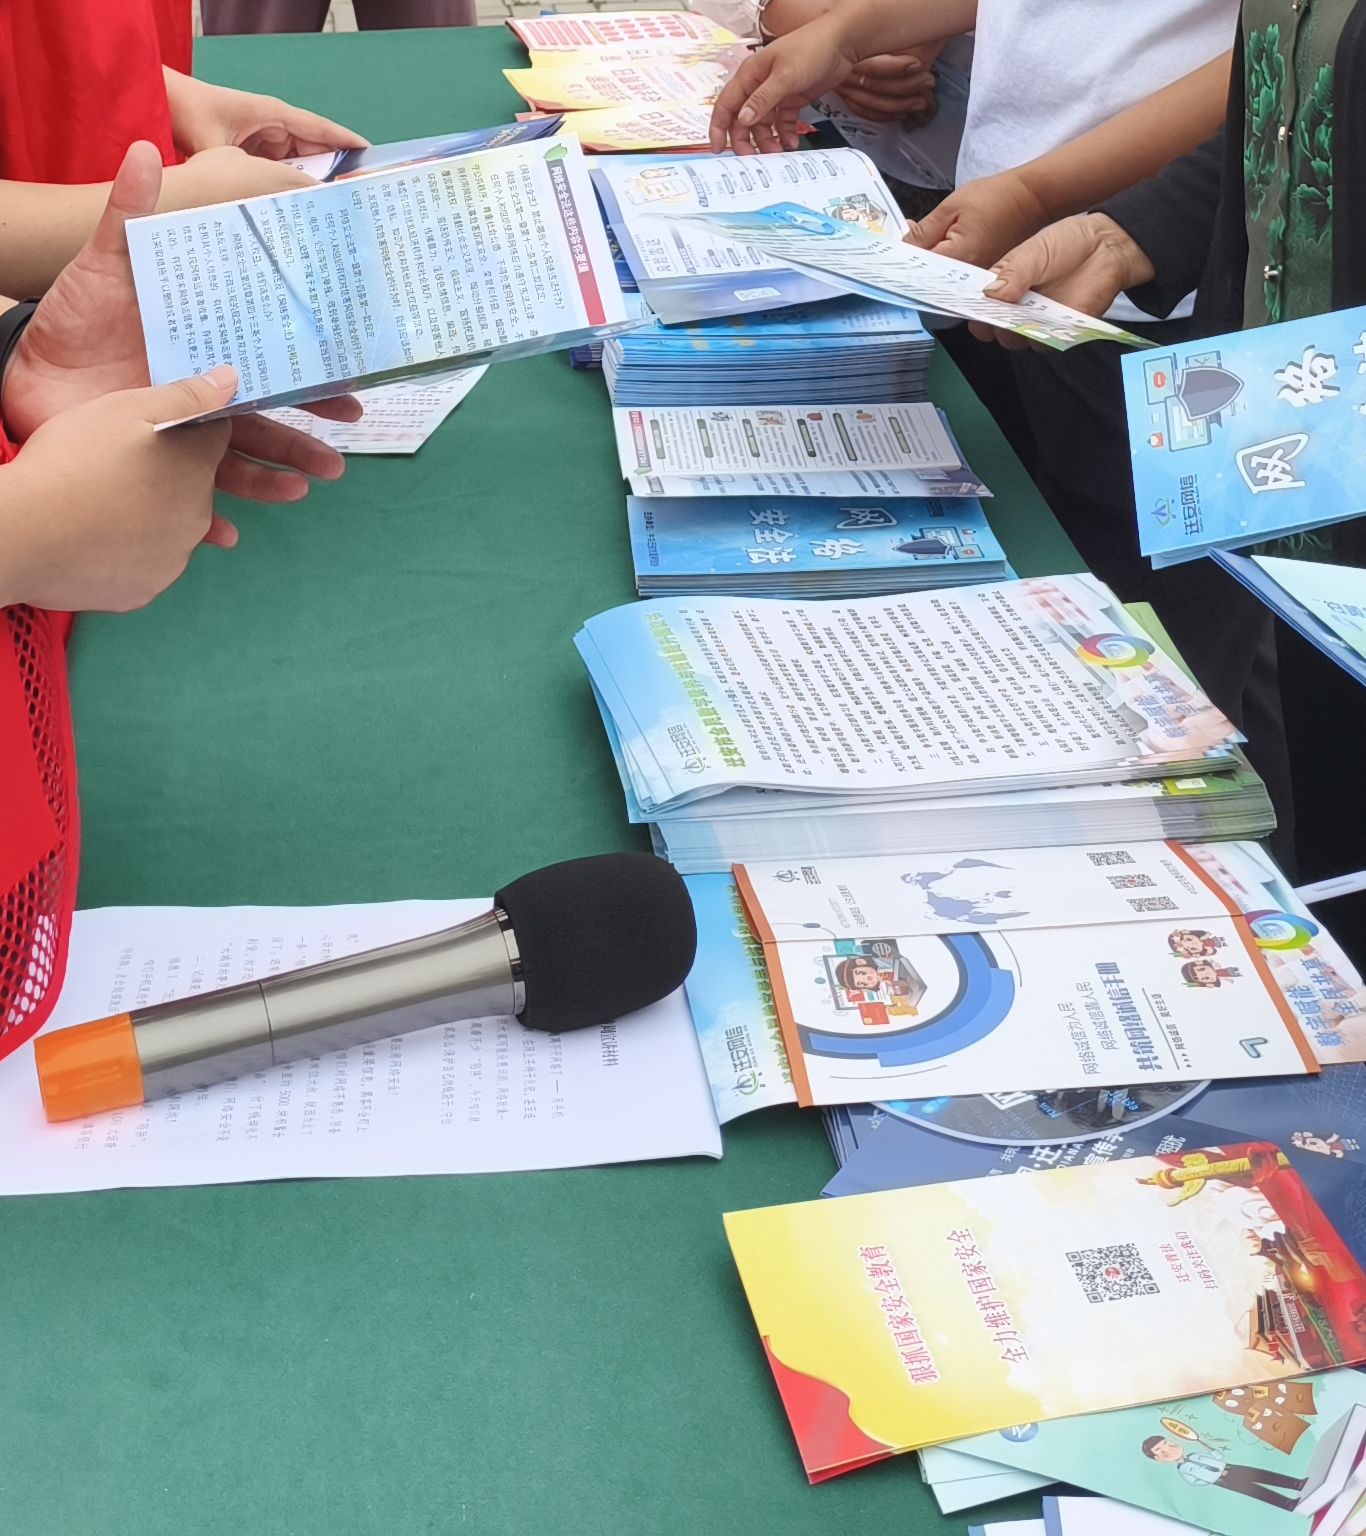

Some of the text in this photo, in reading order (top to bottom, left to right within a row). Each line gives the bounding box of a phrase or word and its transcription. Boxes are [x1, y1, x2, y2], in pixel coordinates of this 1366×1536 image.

[1178, 473, 1200, 536] 迁安网信
[747, 508, 797, 564] 安全法
[1138, 671, 1199, 715] 全民共享
[665, 724, 697, 757] 迁安网信
[1073, 980, 1122, 1050] 网络诚信靠人民
[1090, 961, 1168, 1071] 共筑网络诚信手册
[1285, 986, 1343, 1047] 数字赋能
[1300, 958, 1359, 1015] 全民共享
[725, 1025, 753, 1073] 迁安网信
[1053, 1001, 1105, 1075] 网络诚信为人民
[1160, 1242, 1191, 1284] 迁安普法
[1177, 1230, 1220, 1290] 扫码关注我们
[858, 1243, 942, 1385] 狠抓国家安全教育
[946, 1227, 1032, 1366] 全力维护国家安全
